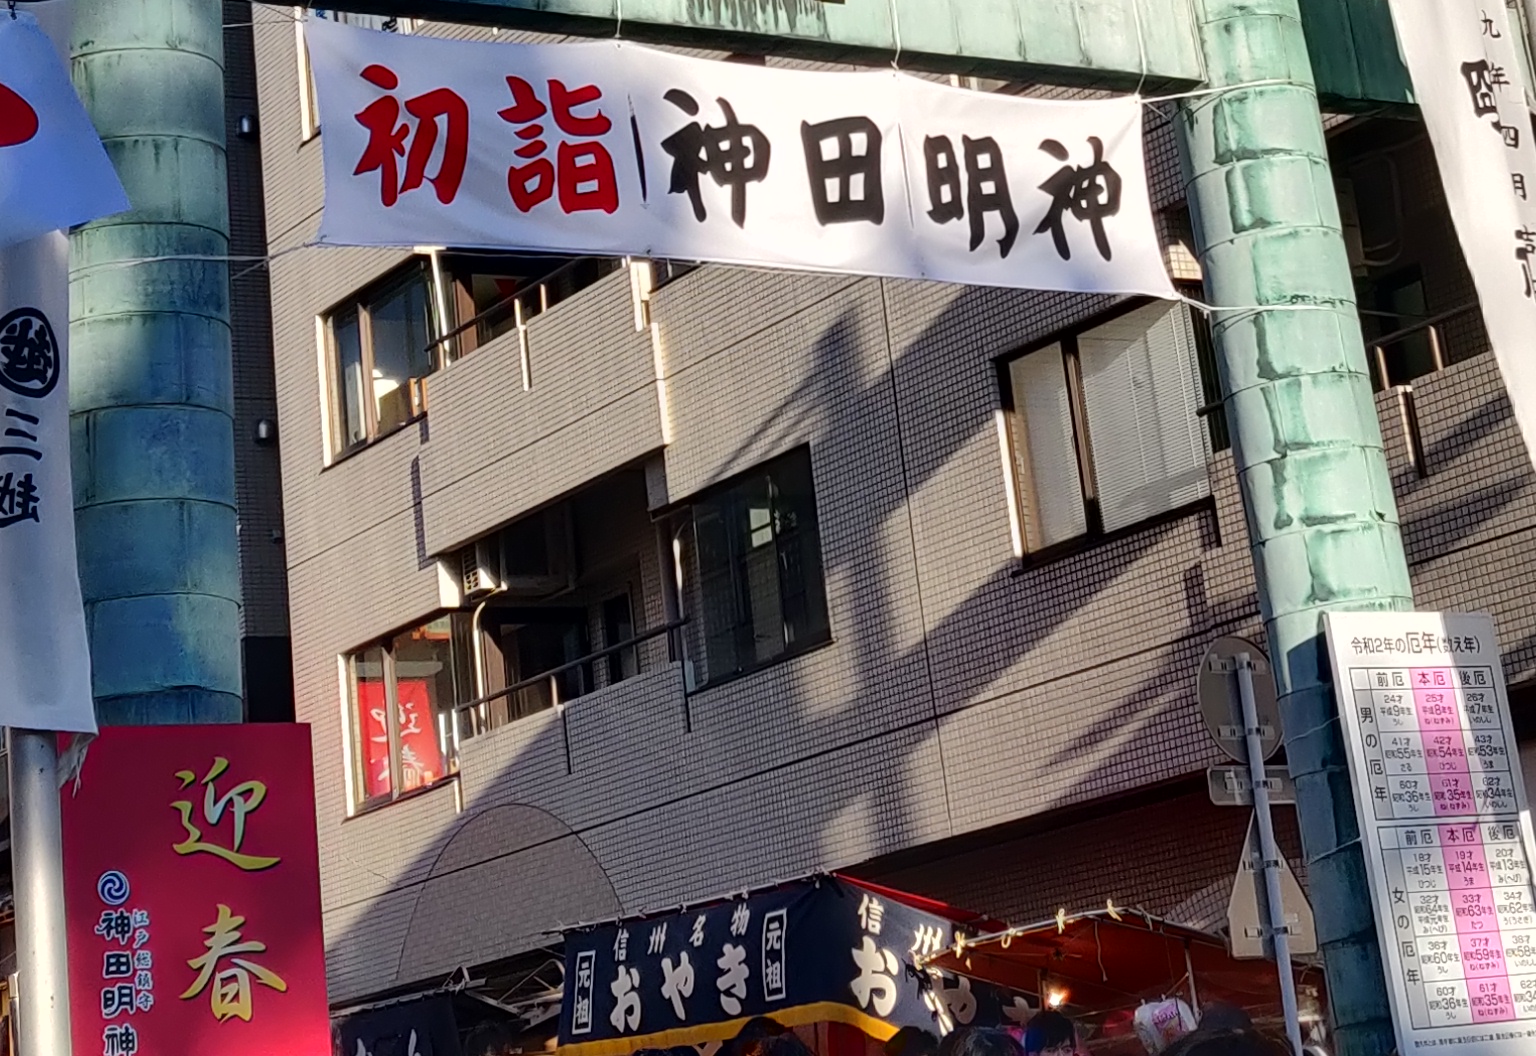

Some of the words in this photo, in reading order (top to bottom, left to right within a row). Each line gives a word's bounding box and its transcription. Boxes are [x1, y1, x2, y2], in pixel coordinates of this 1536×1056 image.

[353, 64, 621, 215] 初詣
[660, 87, 1124, 262] 神田明神
[1350, 631, 1481, 654] 令和2年の厄年(数え年)
[1376, 672, 1404, 687] 前厄
[1417, 671, 1446, 685] 本厄
[1458, 670, 1486, 685] 後厄
[1384, 695, 1403, 704] 24才
[1425, 694, 1443, 703] 25才
[1466, 693, 1485, 702] 26才
[1380, 704, 1413, 716] 平成9年生
[1422, 704, 1454, 715] 平成8年生
[1391, 737, 1410, 746] 41才
[1433, 736, 1452, 745] 42才
[1475, 735, 1492, 744] 43才
[1360, 707, 1387, 802] 男の厄年
[1399, 780, 1418, 790] 60才
[1441, 778, 1459, 788] 61才
[1482, 776, 1500, 786] 62才
[1404, 829, 1433, 845] 前厄
[1446, 827, 1475, 842] 本厄
[1488, 825, 1516, 840] 後厄
[1413, 852, 1431, 862] 18才
[1455, 850, 1473, 860] 19才
[1495, 848, 1514, 857] 20才
[1406, 864, 1443, 875] 平成15年生
[1448, 861, 1484, 873] 平成14年生
[1490, 859, 1526, 870] 平成13年生
[172, 756, 288, 1025] 迎春
[1419, 895, 1438, 905] 32才
[1462, 894, 1481, 903] 33才
[1503, 891, 1522, 900] 34才
[1455, 905, 1494, 917] 昭和63年生
[613, 902, 751, 962] 信州名物
[857, 893, 943, 955] 信州
[1392, 887, 1420, 985] 女の厄年
[1428, 941, 1447, 951] 36才
[1470, 938, 1489, 947] 37才
[1512, 935, 1531, 944] 38才
[132, 908, 154, 1012] 江戸総鎮守
[766, 921, 782, 990] 元祖
[1421, 952, 1460, 964] 昭和60年生
[1464, 948, 1501, 961] 昭和59年生
[95, 910, 138, 1056] 神田明神
[610, 943, 750, 1033] おやき
[1436, 986, 1456, 996] 60才
[1479, 983, 1497, 993] 61才
[575, 961, 591, 1024] 元祖
[1429, 997, 1468, 1010] 昭和36年生
[1471, 994, 1510, 1007] 昭和35年生
